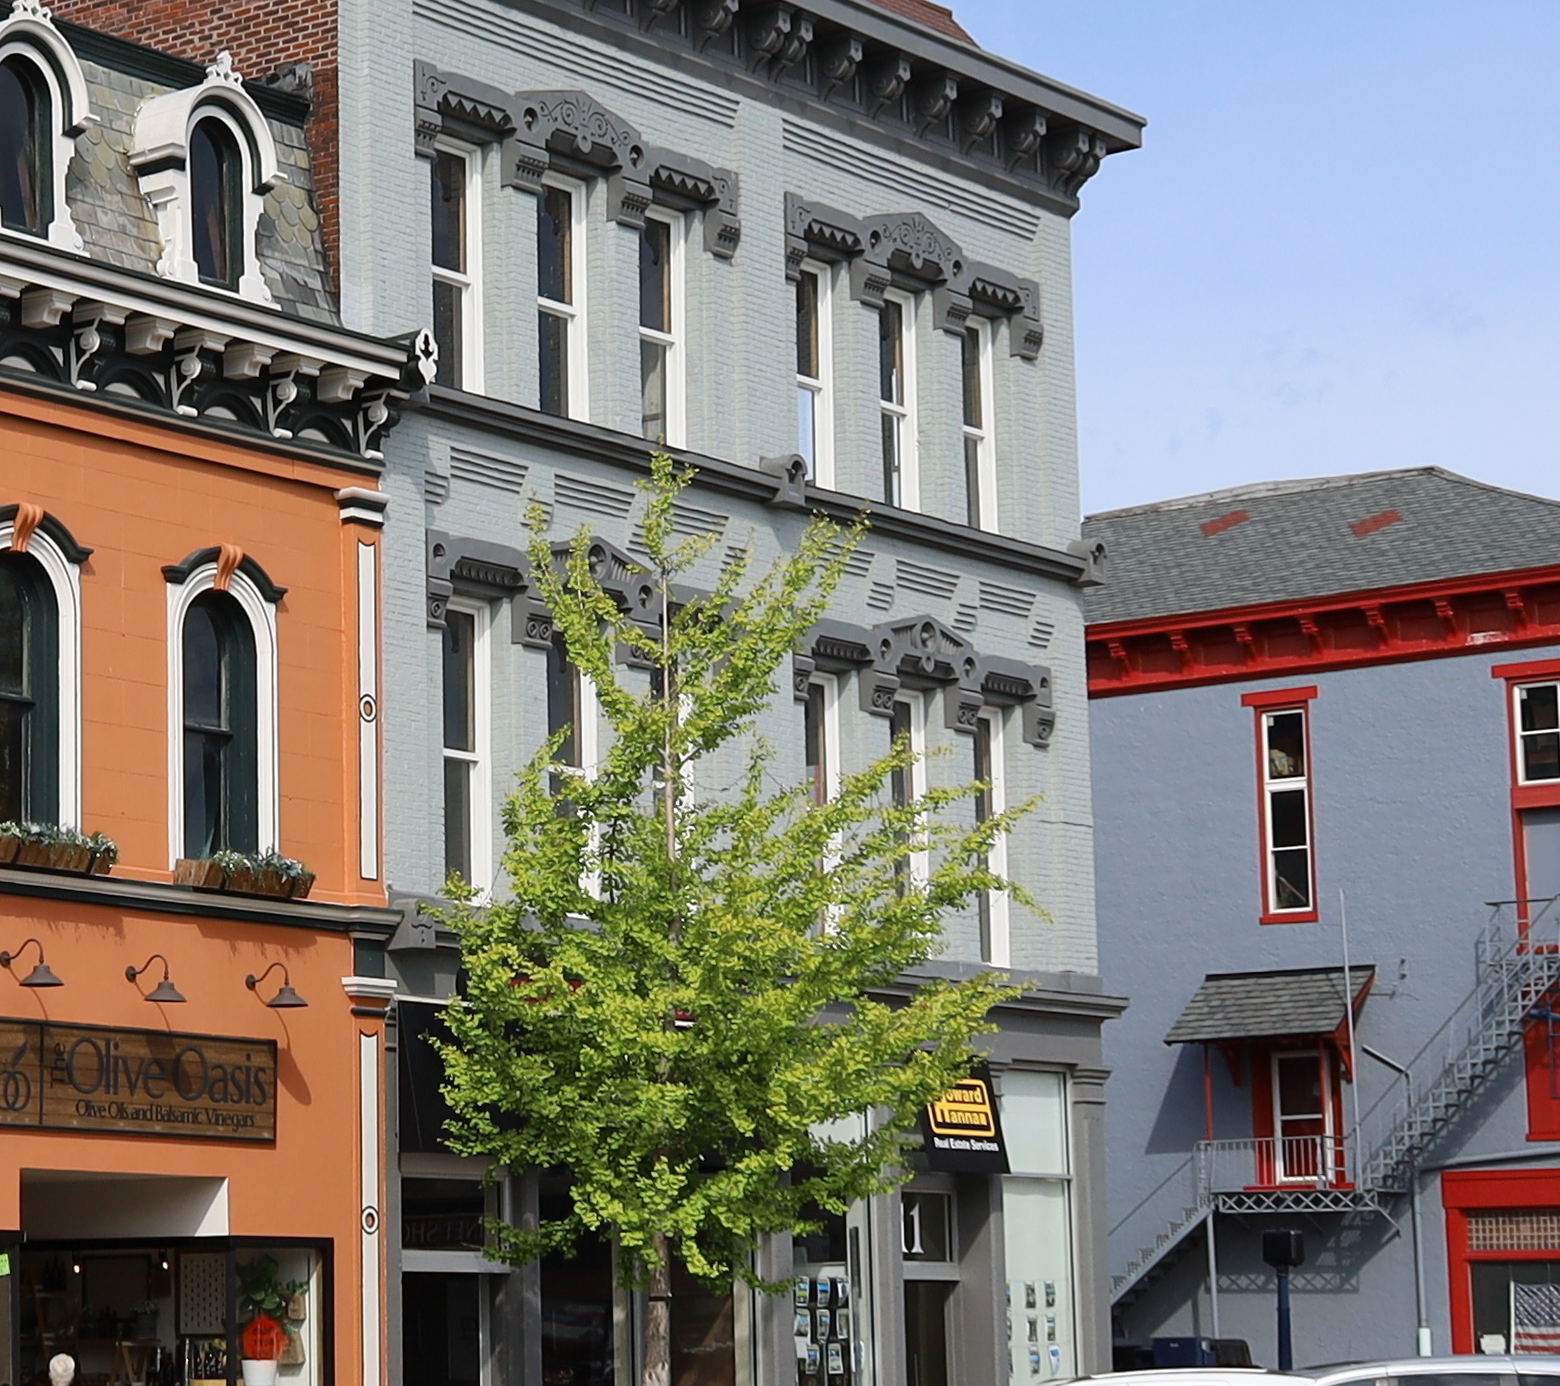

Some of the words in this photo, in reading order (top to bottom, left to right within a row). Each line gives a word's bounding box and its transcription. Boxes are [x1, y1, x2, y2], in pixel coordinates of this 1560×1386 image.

[51, 1043, 65, 1089] The
[66, 1036, 168, 1099] Olive
[172, 1045, 268, 1107] Oasis
[75, 1099, 107, 1119] Olive
[108, 1100, 129, 1121] Oils
[131, 1102, 153, 1122] and
[155, 1104, 202, 1124] Balsamic
[202, 1107, 255, 1132] Vinegars
[933, 1136, 950, 1149] Real
[950, 1138, 970, 1150] Estate
[970, 1139, 1000, 1152] Services
